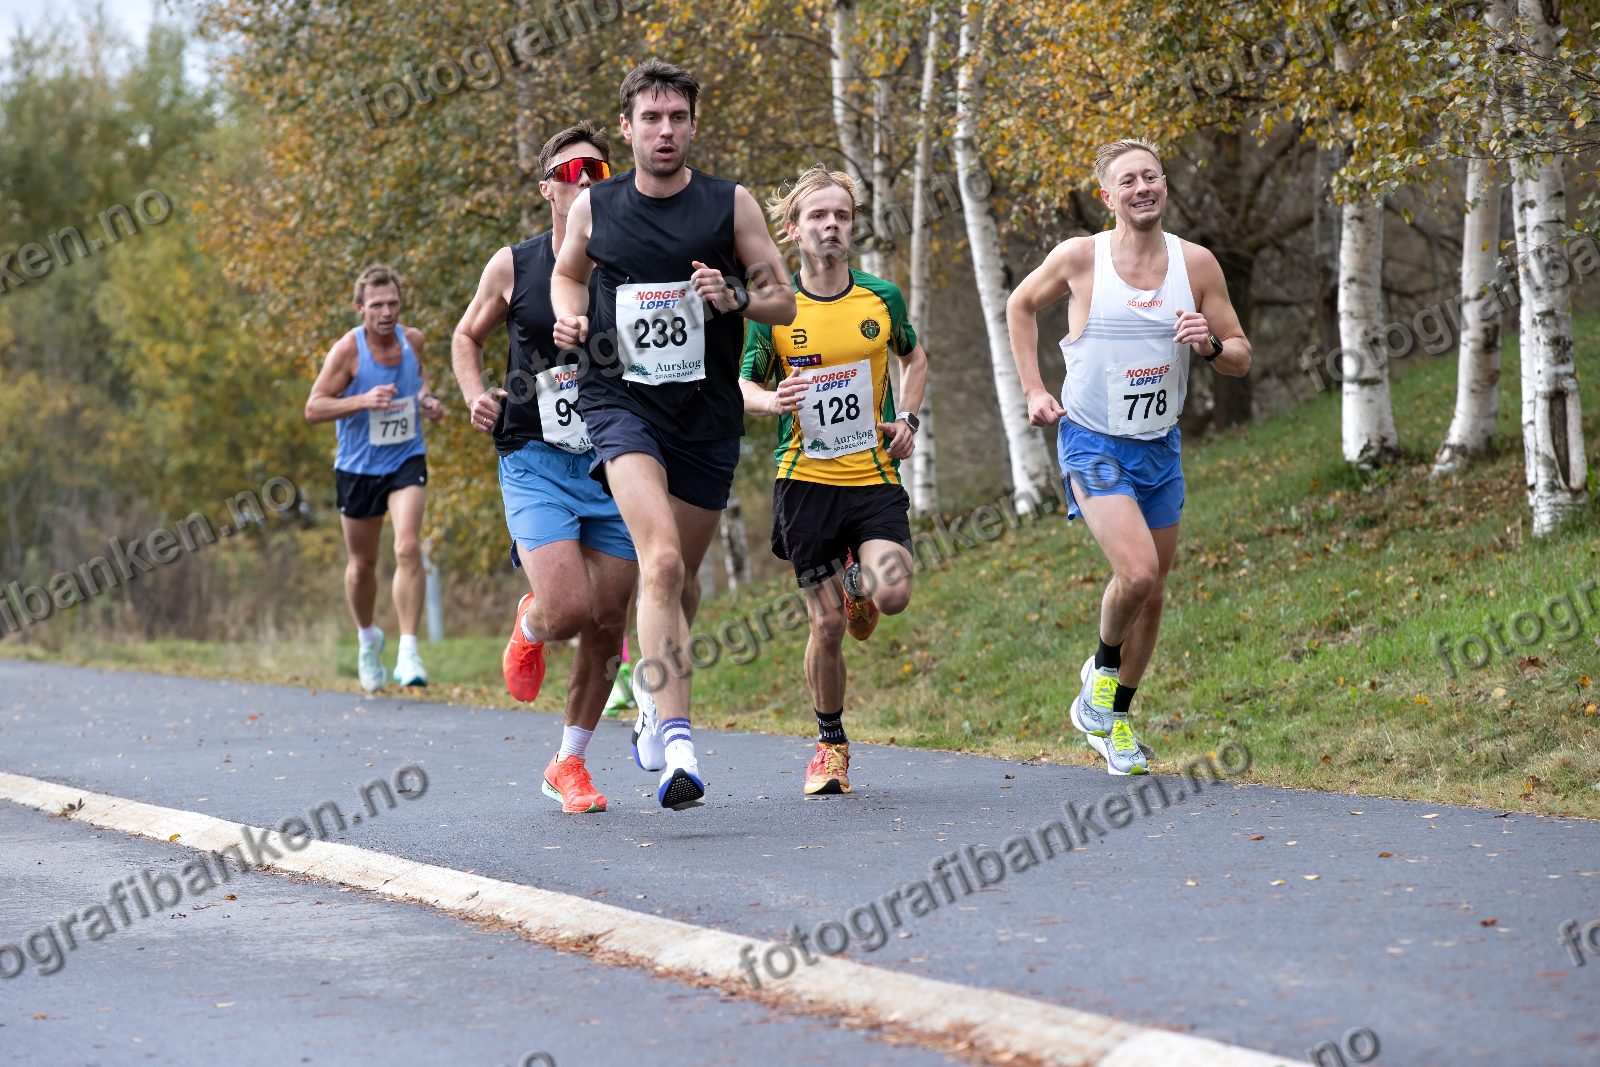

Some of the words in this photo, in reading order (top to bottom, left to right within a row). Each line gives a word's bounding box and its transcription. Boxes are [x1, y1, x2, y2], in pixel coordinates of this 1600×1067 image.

[636, 289, 686, 301] NORGES
[640, 299, 679, 310] LØPET
[1126, 299, 1163, 308] saucony
[634, 316, 688, 348] 238
[655, 360, 701, 373] Aurskog
[1125, 364, 1170, 378] NORGES
[811, 369, 858, 384] NORGES
[1129, 375, 1163, 387] LØPET
[815, 379, 851, 392] LØPET
[813, 393, 860, 426] 128
[1123, 389, 1167, 420] 778
[380, 418, 408, 437] 779
[833, 429, 874, 446] Aurskog
